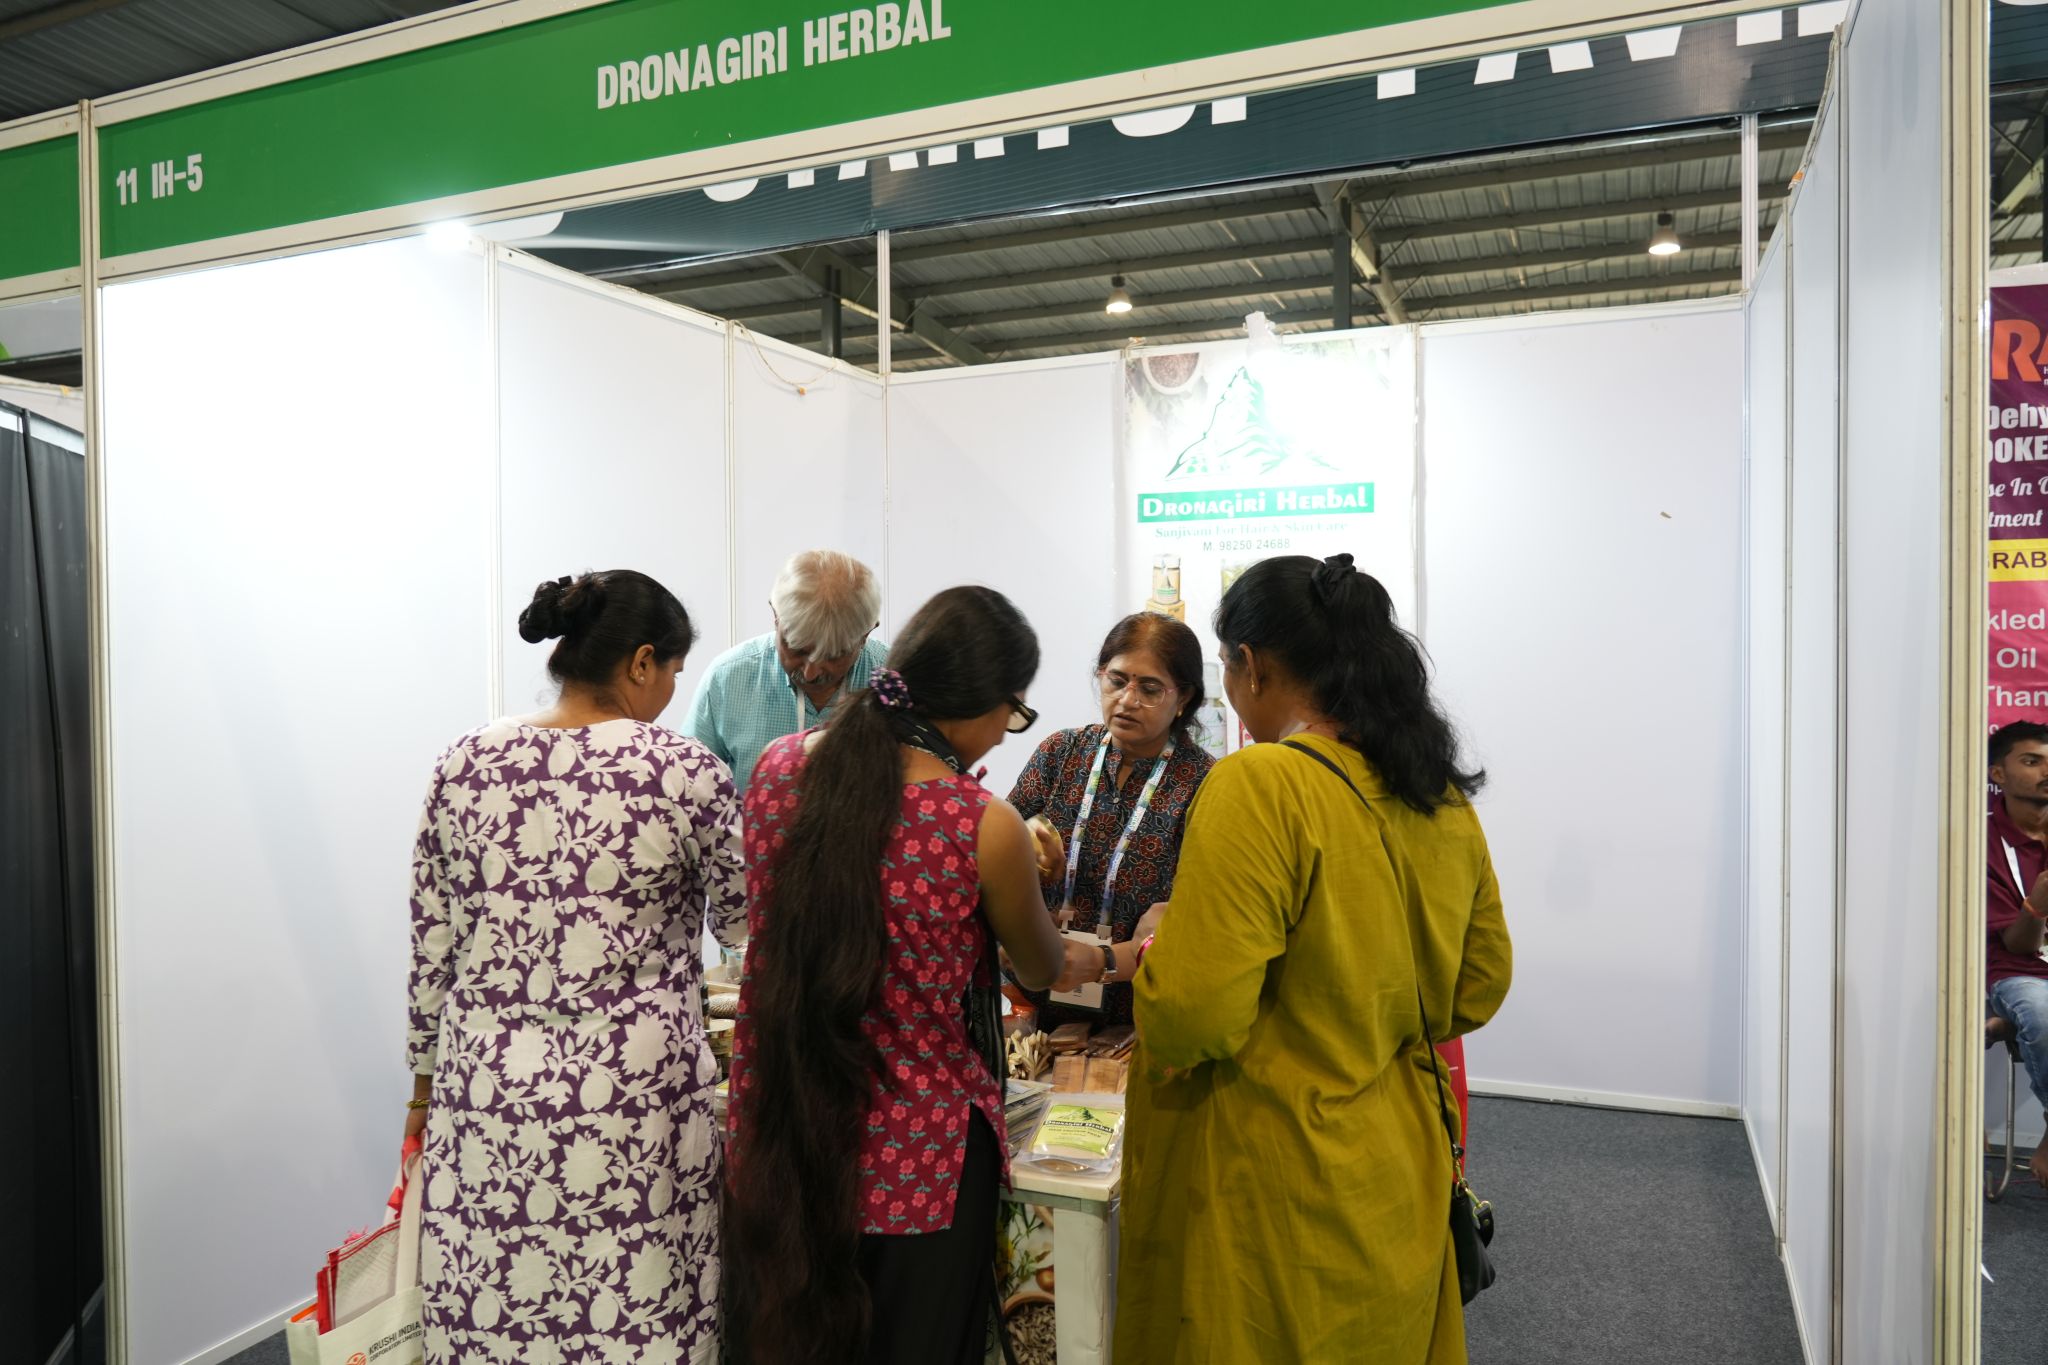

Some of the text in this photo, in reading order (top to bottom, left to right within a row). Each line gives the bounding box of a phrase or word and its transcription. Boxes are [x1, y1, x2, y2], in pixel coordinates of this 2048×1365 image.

[596, 0, 952, 110] DRONAGIRI HERBAL
[116, 153, 204, 206] 11 IH-5
[1992, 319, 2048, 382] R
[1988, 435, 2048, 463] OKE
[2010, 477, 2033, 496] In
[1219, 539, 1252, 551] 98250
[1988, 551, 2048, 570] RAB
[1996, 647, 2037, 669] Oil
[368, 1321, 421, 1355] KRUSHI INDIA
